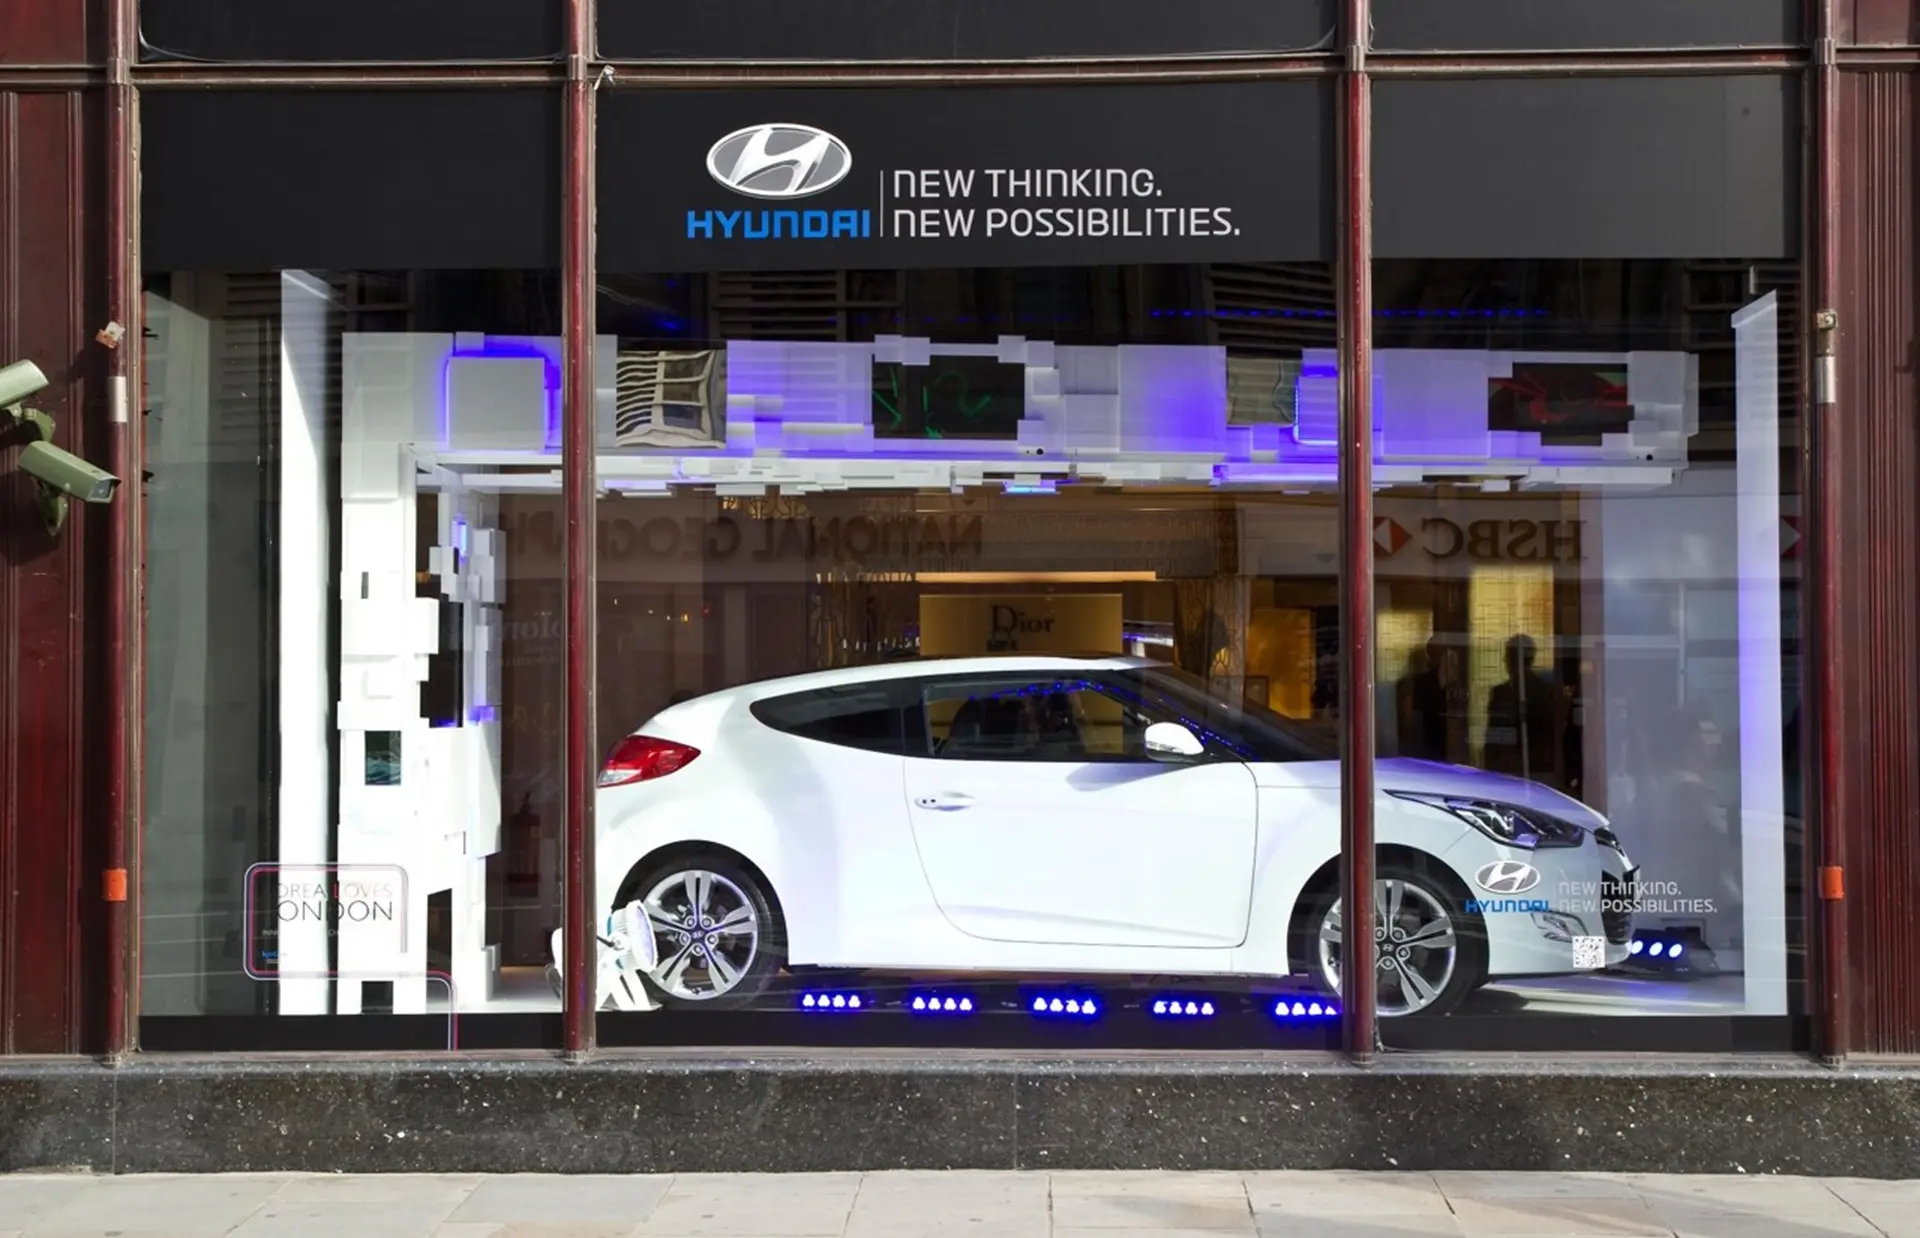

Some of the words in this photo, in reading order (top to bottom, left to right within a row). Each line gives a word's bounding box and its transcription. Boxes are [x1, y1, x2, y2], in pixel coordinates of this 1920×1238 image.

[893, 169, 975, 199] NEW
[984, 168, 1162, 198] THINKING.
[687, 209, 870, 239] HYUNDAI
[893, 209, 975, 238] NEW
[986, 207, 1241, 237] POSSIBILITIES.
[988, 604, 1055, 634] Dior
[1558, 882, 1596, 896] NEW
[1601, 881, 1681, 896] THINKING.
[1465, 900, 1549, 914] HYUNDAI
[1558, 900, 1596, 913] NEW
[1601, 899, 1718, 914] POSSIBILITIES.
